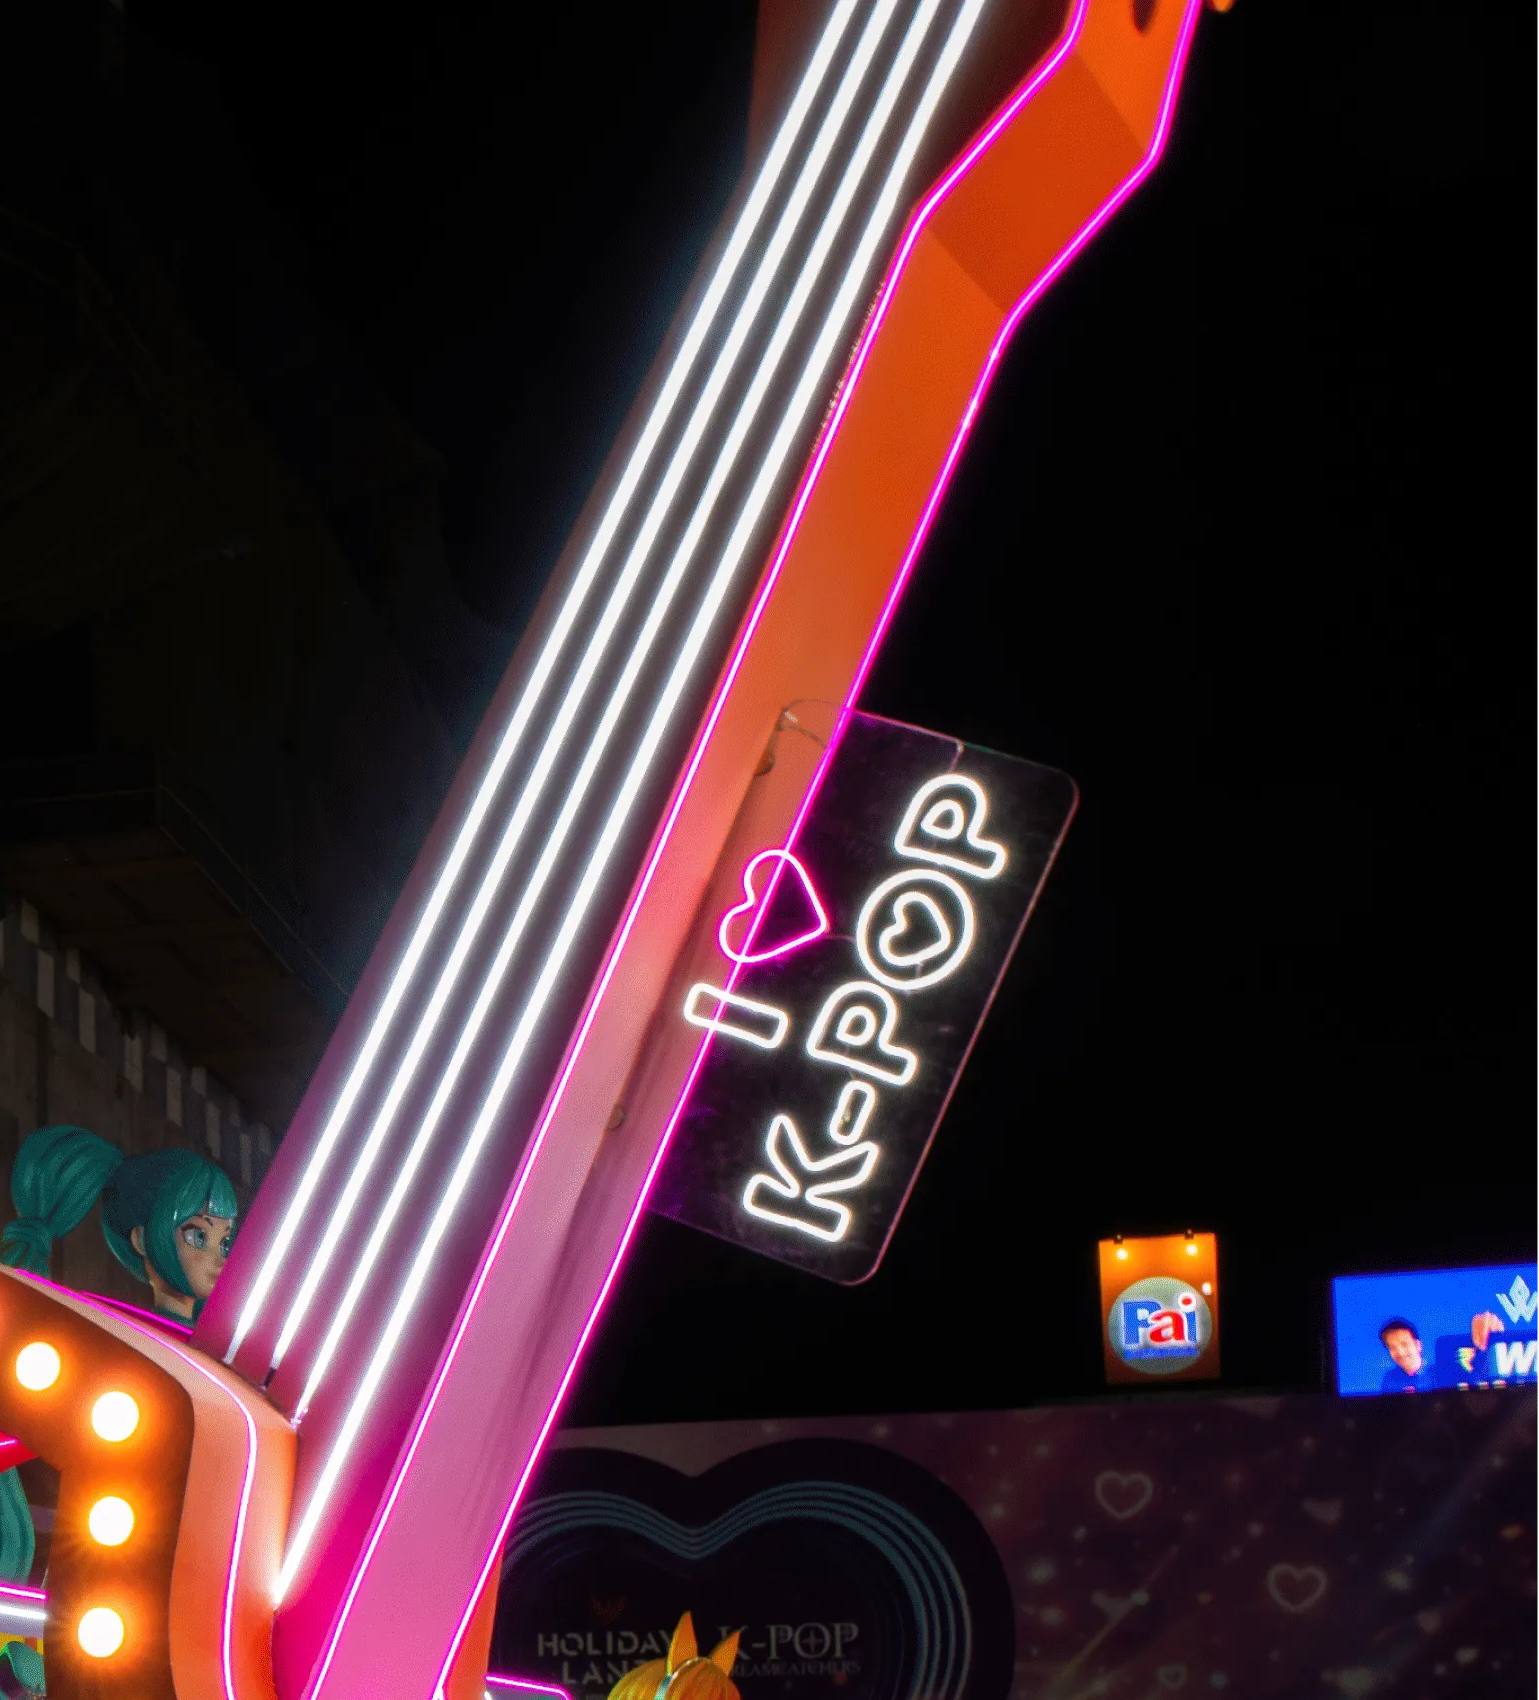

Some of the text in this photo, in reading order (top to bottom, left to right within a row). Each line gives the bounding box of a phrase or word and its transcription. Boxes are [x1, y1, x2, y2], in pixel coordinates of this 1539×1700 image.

[683, 982, 791, 1049] I
[742, 772, 1008, 1243] K-POP
[1122, 1294, 1199, 1347] Pai
[561, 1660, 648, 1685] LAN
